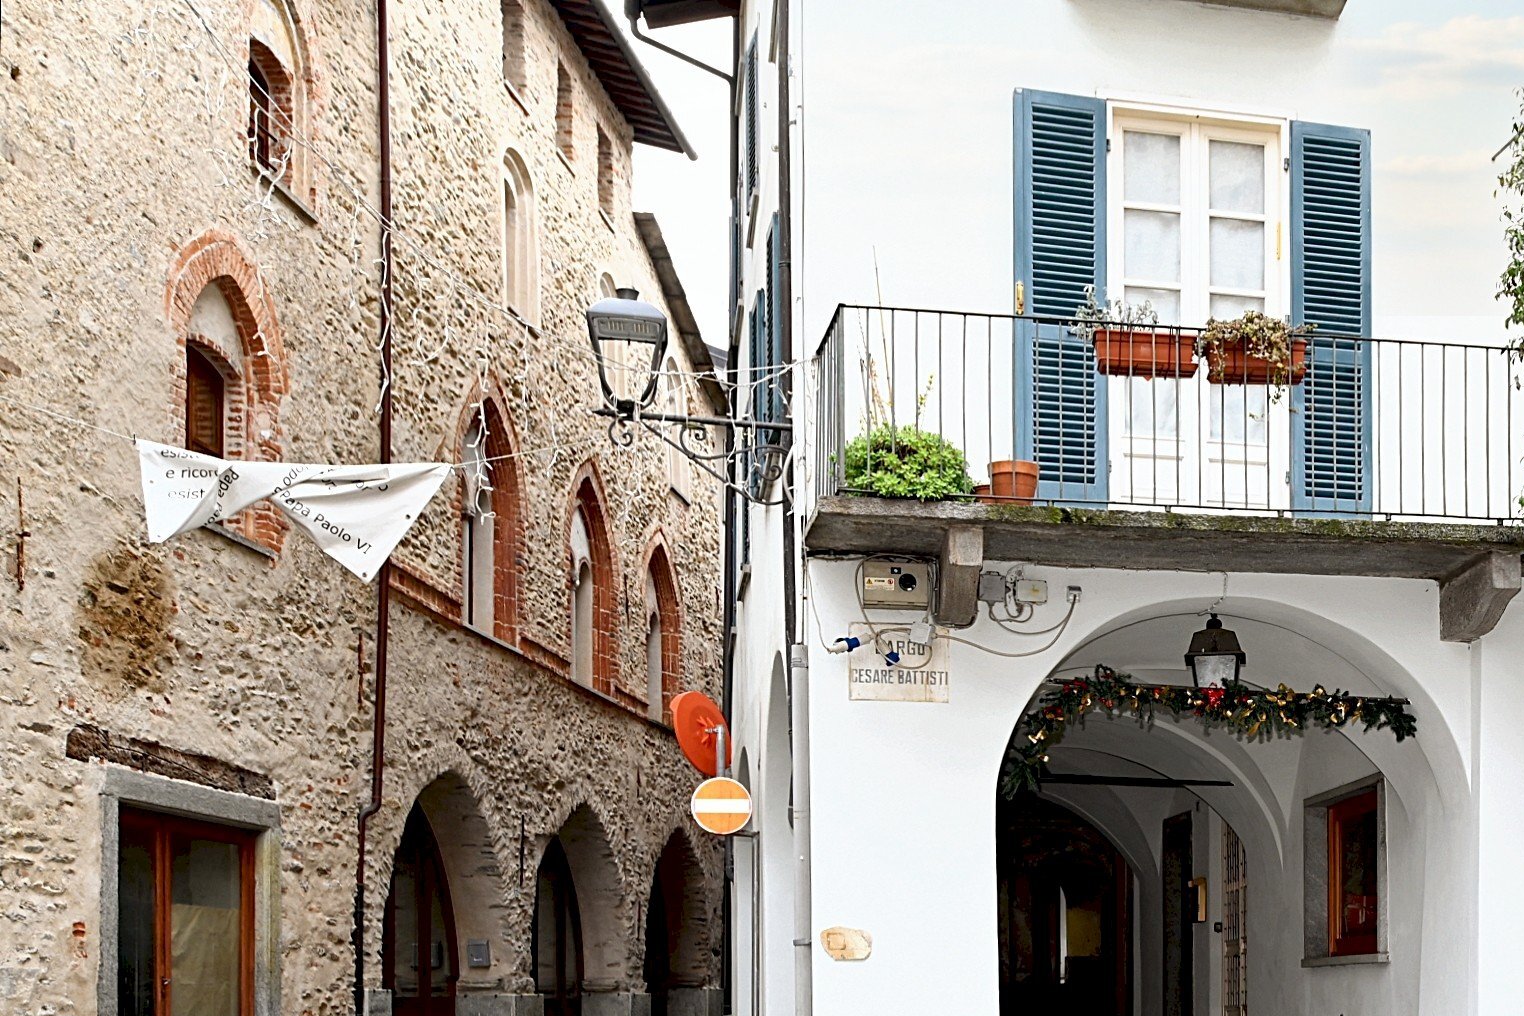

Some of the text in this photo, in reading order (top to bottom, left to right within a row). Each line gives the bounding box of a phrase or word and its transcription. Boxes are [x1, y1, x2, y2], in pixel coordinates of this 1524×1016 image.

[165, 469, 175, 479] e
[279, 490, 372, 555] Papa Paolo VI
[852, 668, 949, 685] CESARE BATTISTI
